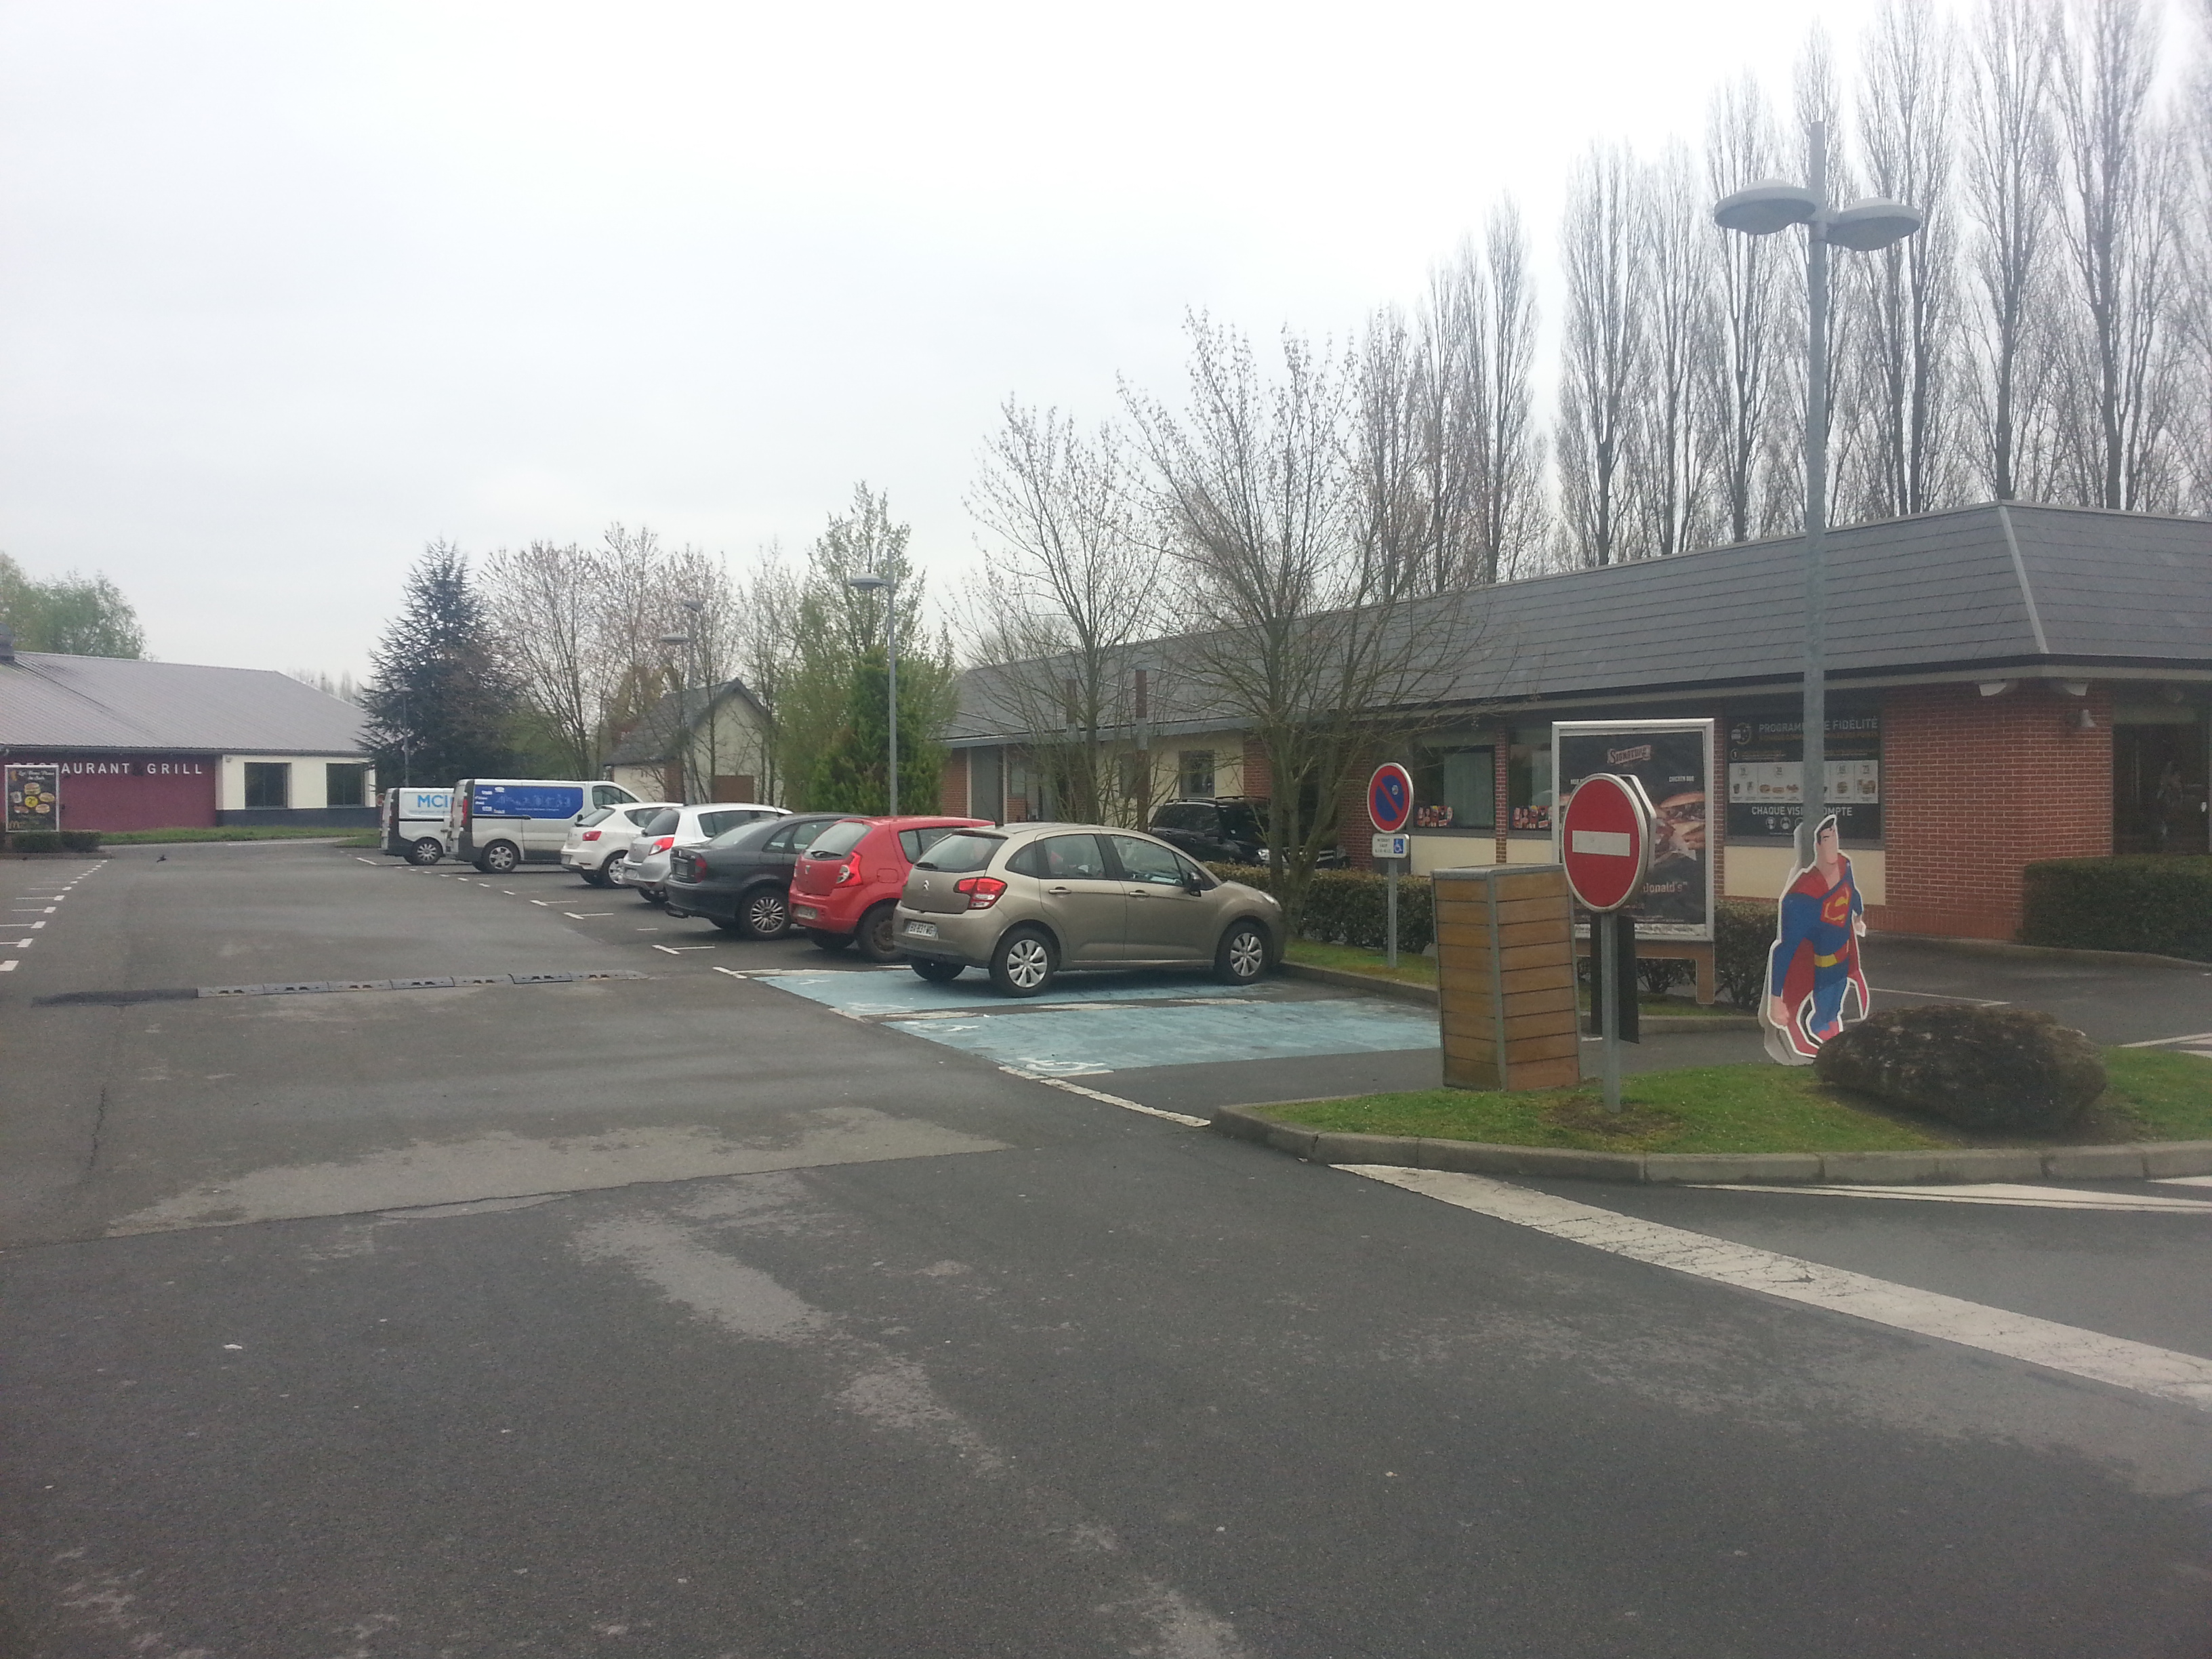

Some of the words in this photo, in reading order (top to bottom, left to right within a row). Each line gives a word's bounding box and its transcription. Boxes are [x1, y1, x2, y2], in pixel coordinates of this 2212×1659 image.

[1759, 722, 1803, 733] PROGRAM
[1832, 716, 1878, 730] FIDÉLITÉ
[146, 763, 202, 774] GRILL
[1752, 806, 1785, 815] CHAQUE
[1787, 806, 1803, 815] VISI
[1822, 806, 1852, 816] OMPTE
